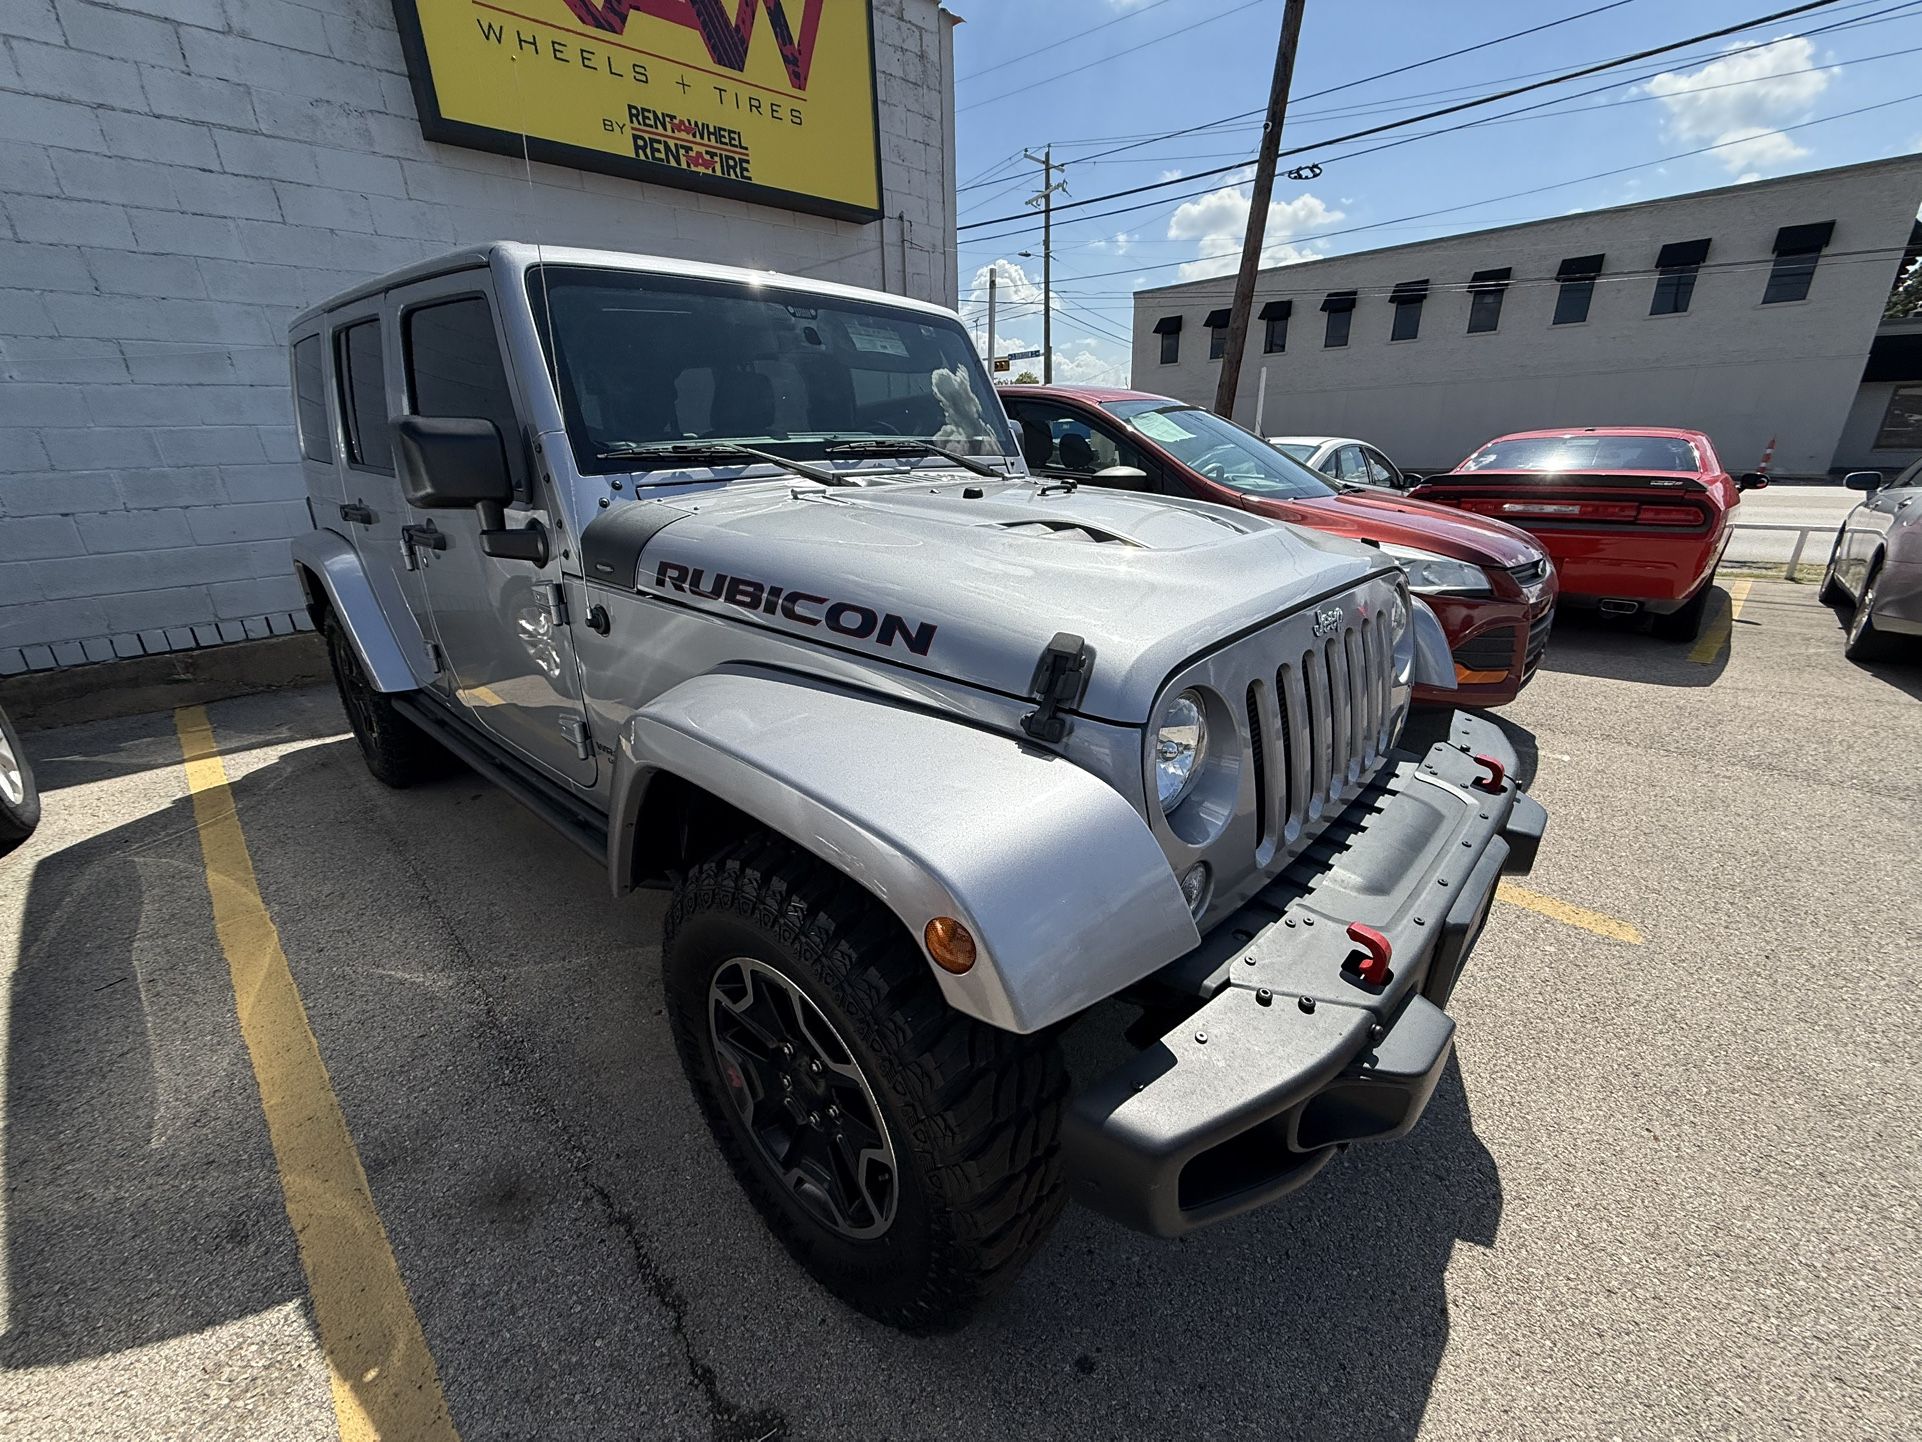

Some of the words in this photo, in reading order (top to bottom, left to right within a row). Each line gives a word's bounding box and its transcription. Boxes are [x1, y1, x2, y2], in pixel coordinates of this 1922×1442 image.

[477, 18, 649, 84] WHEELS
[713, 86, 803, 126] TIRES
[602, 118, 626, 135] BY
[655, 560, 938, 657] RUBICON
[1312, 607, 1343, 637] Jeep
